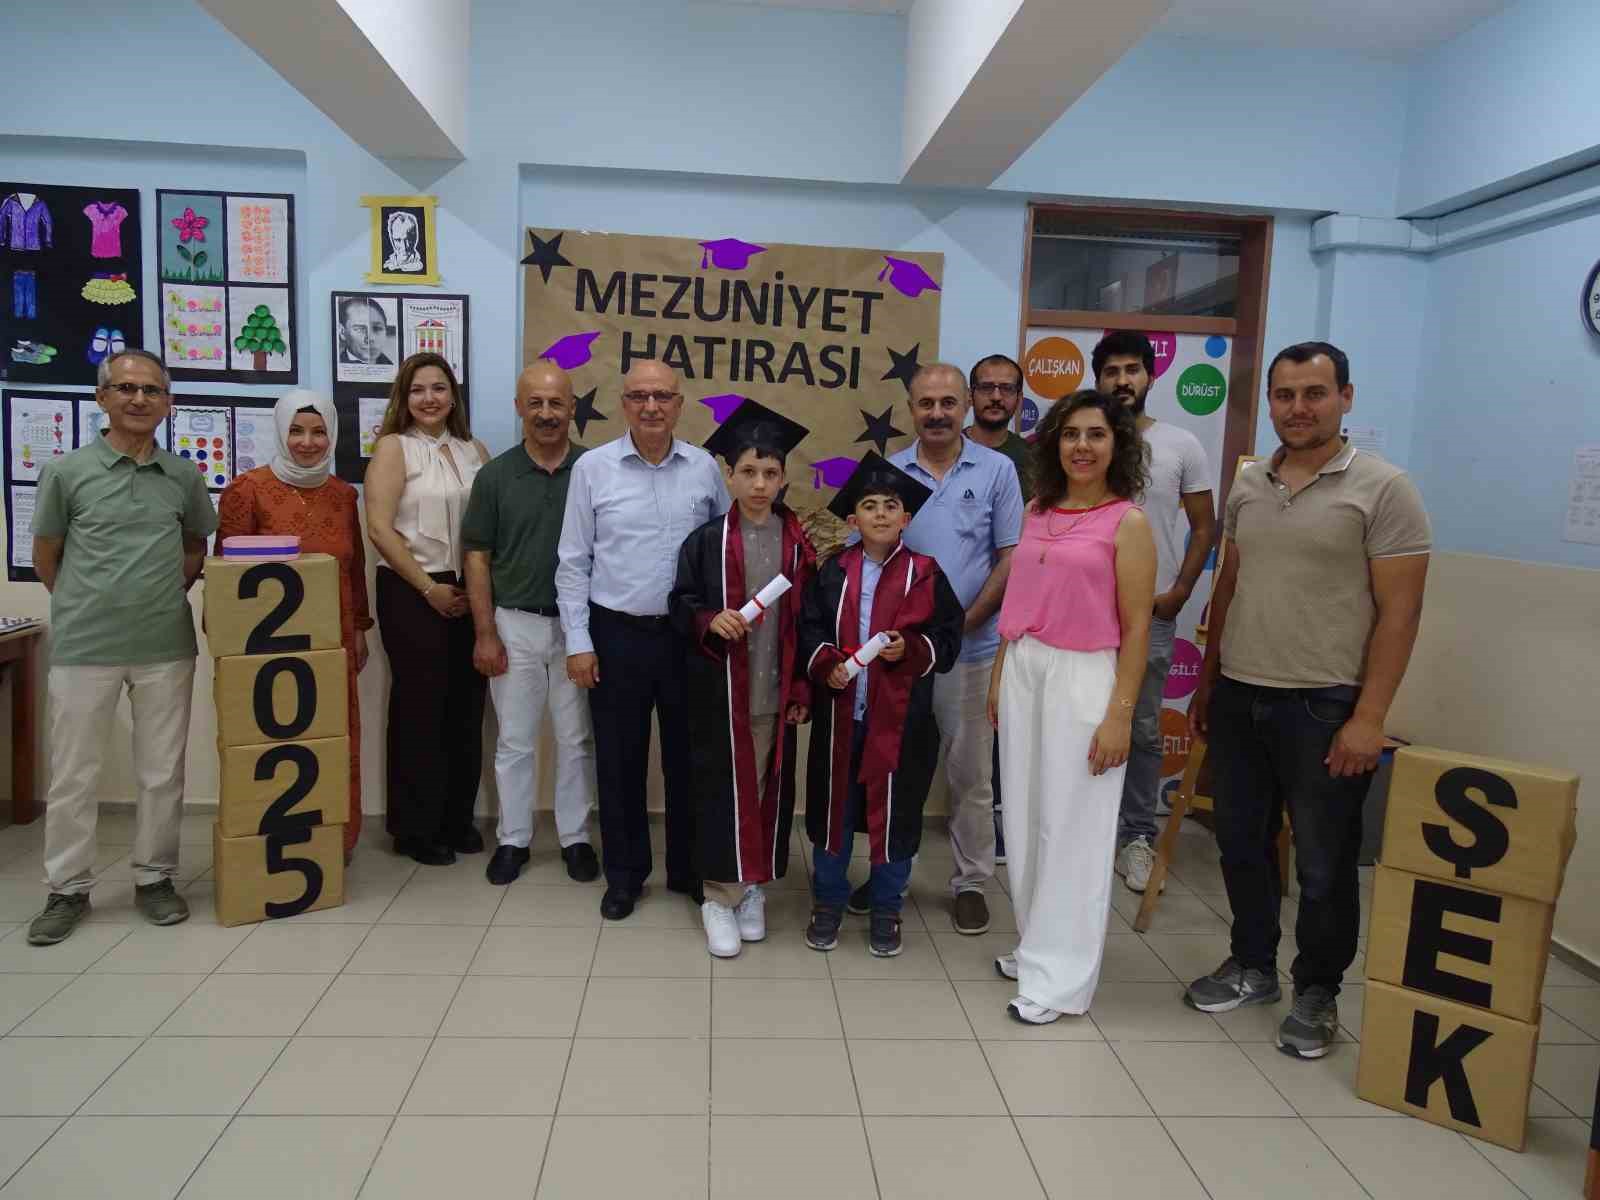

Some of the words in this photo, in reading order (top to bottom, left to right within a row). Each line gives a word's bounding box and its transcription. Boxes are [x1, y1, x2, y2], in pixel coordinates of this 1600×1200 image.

[574, 268, 884, 335] MEZUNİYET
[620, 331, 861, 390] HATIRASI
[1028, 359, 1080, 378] ÇALIŞKAN
[1182, 382, 1220, 397] DÜRÜST
[1168, 662, 1200, 676] GİLİ
